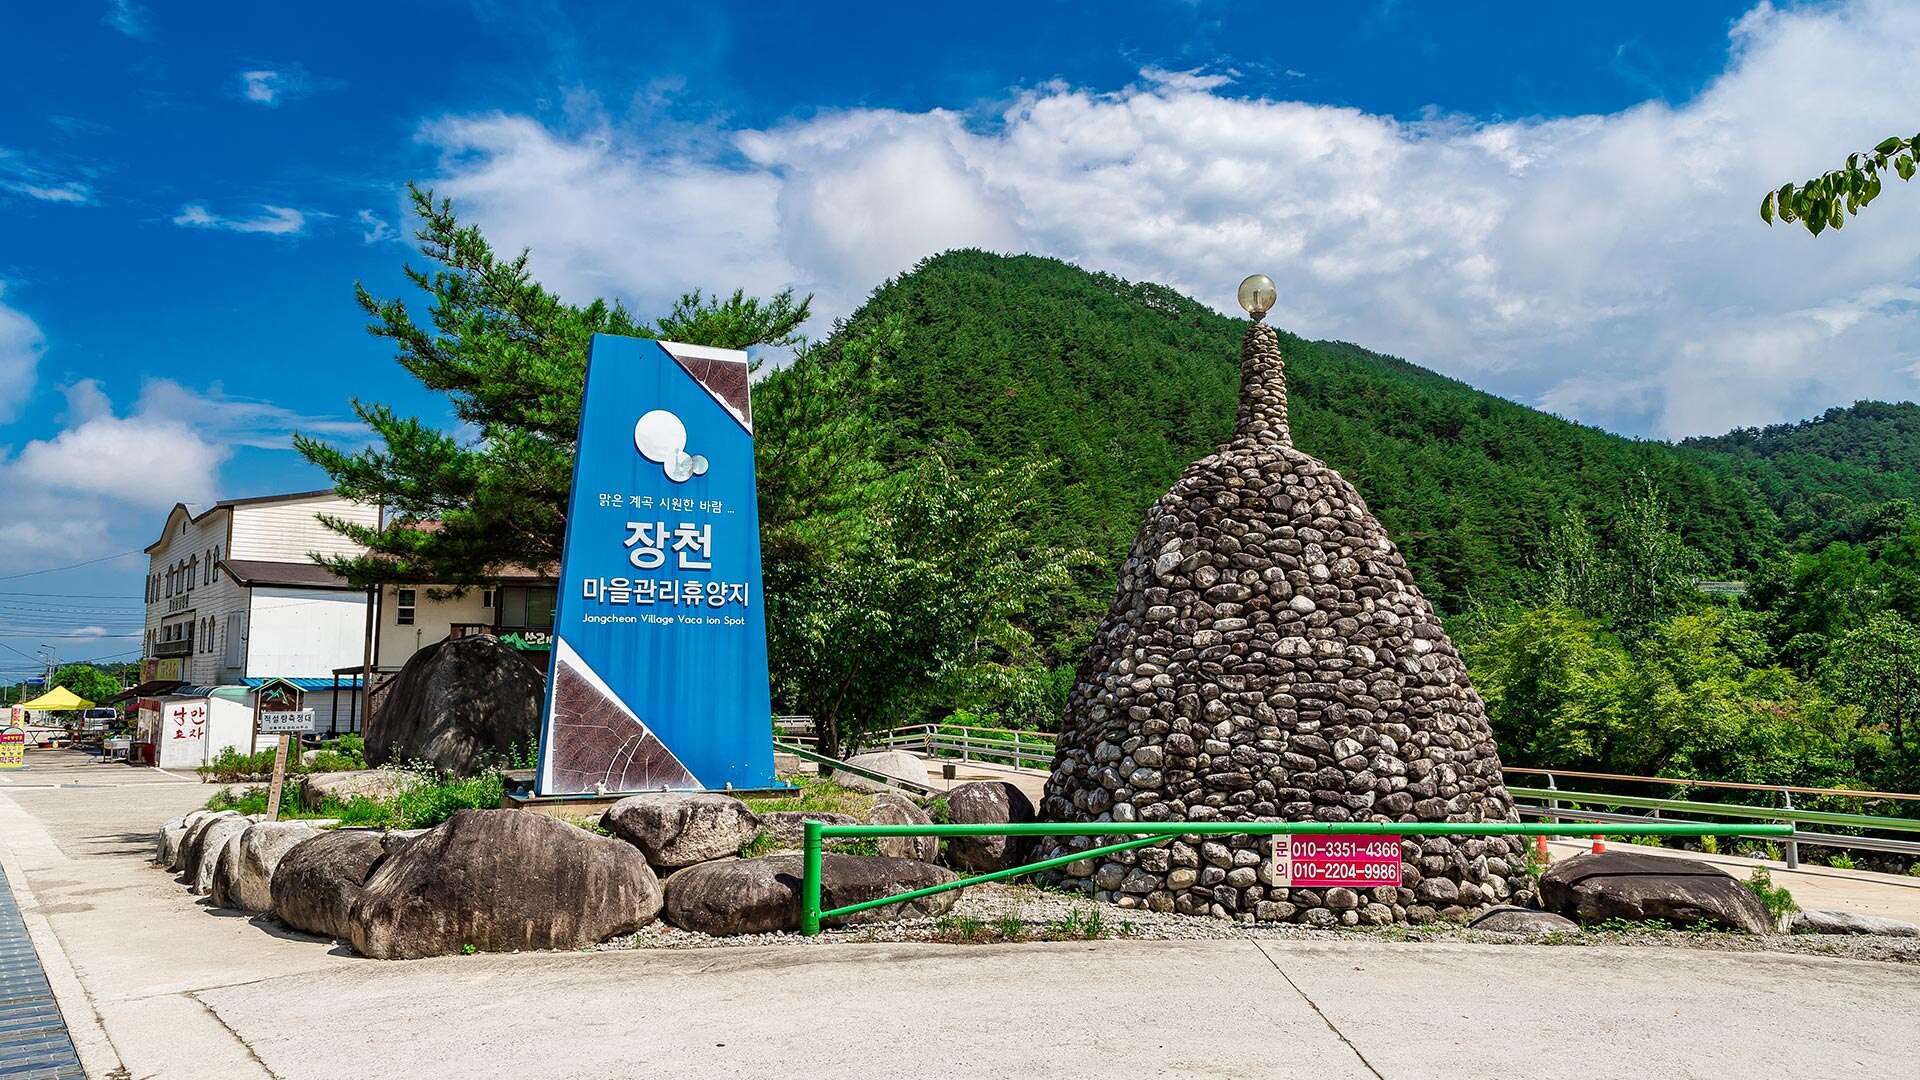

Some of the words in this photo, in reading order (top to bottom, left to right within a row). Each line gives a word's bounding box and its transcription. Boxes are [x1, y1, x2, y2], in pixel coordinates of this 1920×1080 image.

[600, 493, 623, 508] 맑은
[629, 495, 654, 510] 계곡
[659, 497, 694, 512] 시원한
[699, 500, 723, 514] 바람
[623, 521, 712, 570] 장천
[583, 577, 749, 607] 마을관리휴양지
[582, 613, 637, 625] Jangcheon
[641, 614, 674, 626] Village
[724, 616, 745, 627] Spot
[1275, 842, 1288, 879] 문의
[1292, 842, 1399, 858] 010-3351-4366
[1293, 863, 1397, 879] 010-2204-9986
